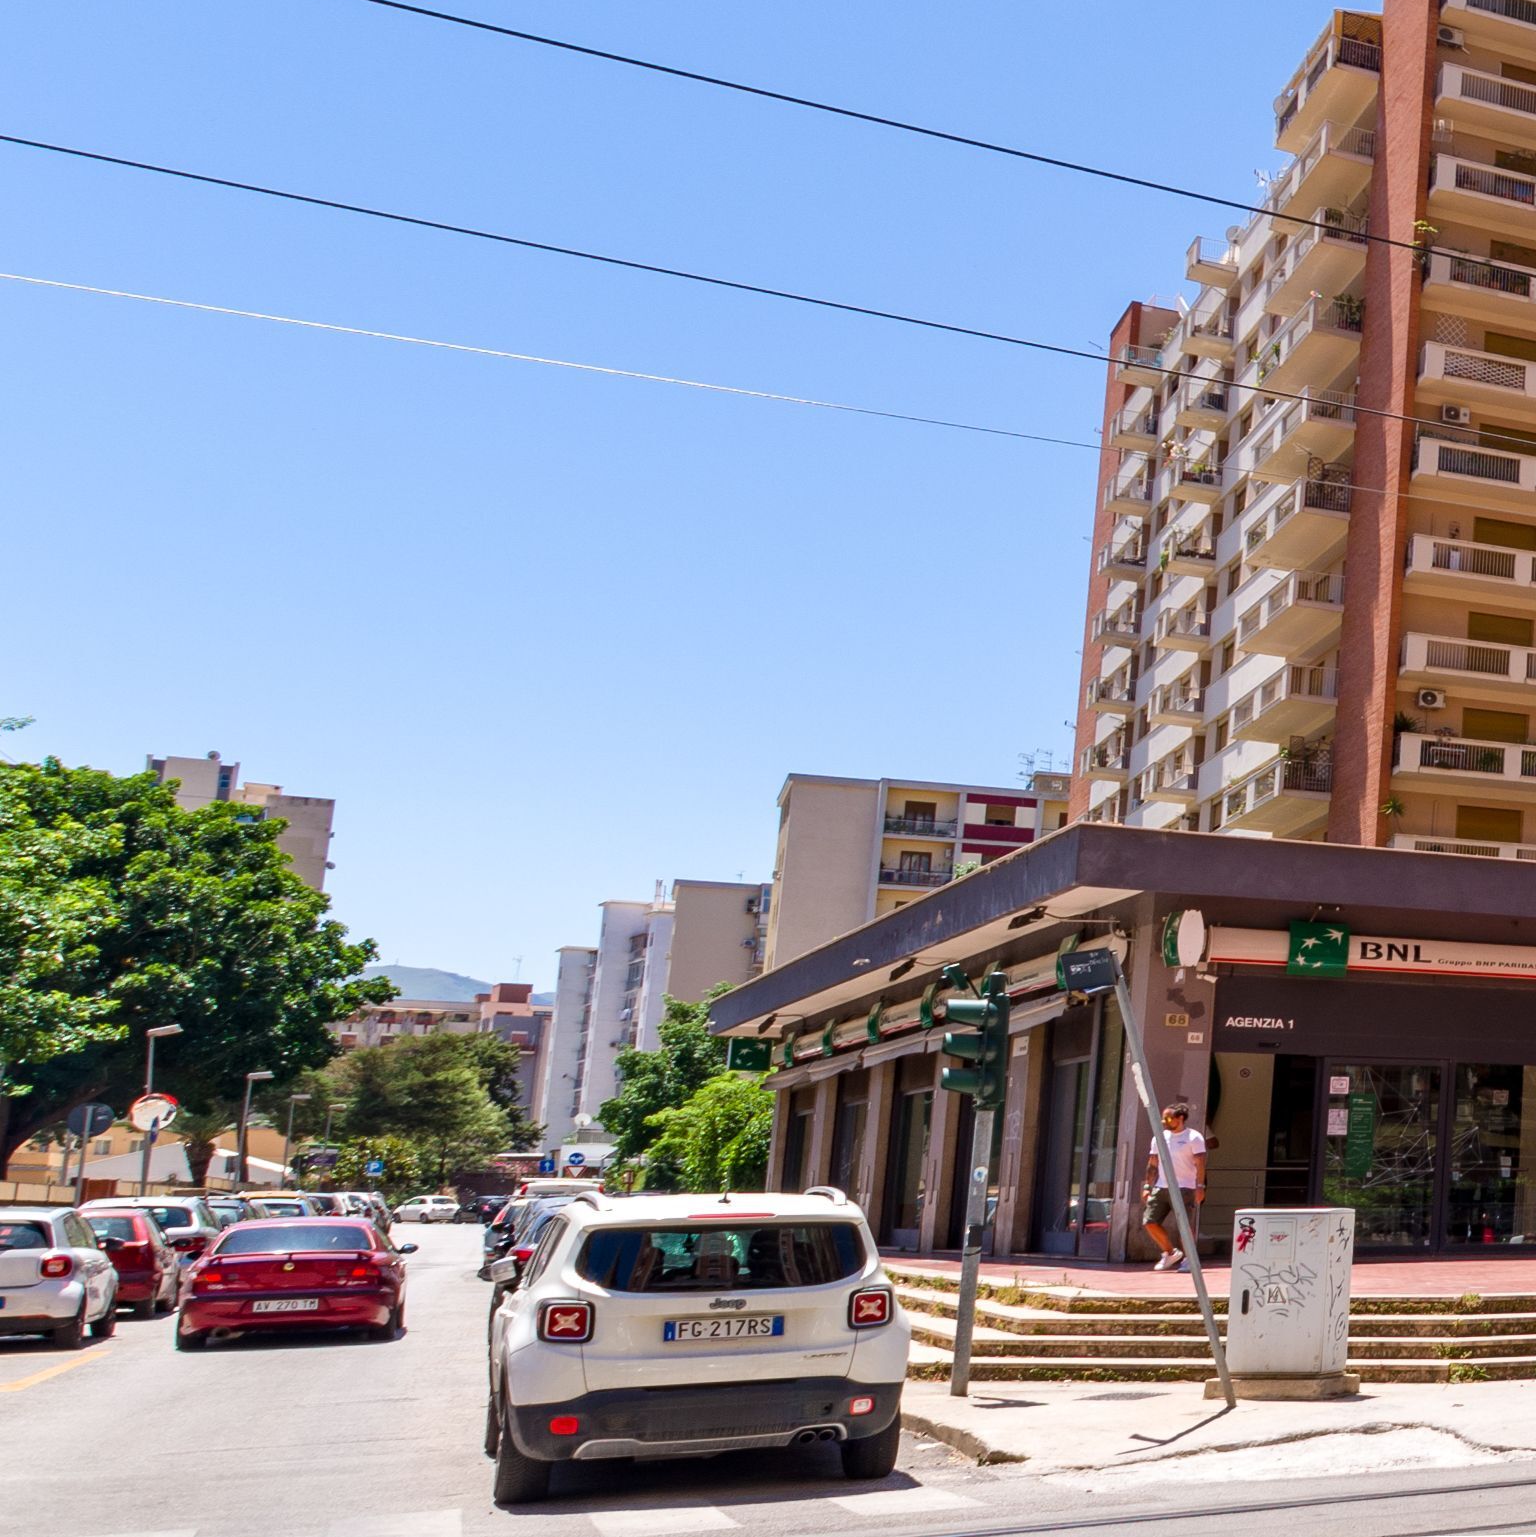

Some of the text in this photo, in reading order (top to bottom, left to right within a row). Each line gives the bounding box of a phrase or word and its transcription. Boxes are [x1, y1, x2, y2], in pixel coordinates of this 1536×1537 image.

[1359, 941, 1432, 964] BNL
[1437, 957, 1473, 967] Gruppo
[1168, 1014, 1186, 1025] 68
[1225, 1016, 1295, 1030] AGENZIA 1
[255, 1299, 317, 1311] AV 270 TM
[709, 1298, 747, 1310] Jeep
[678, 1321, 702, 1339] FG
[710, 1318, 771, 1338] 217RS
